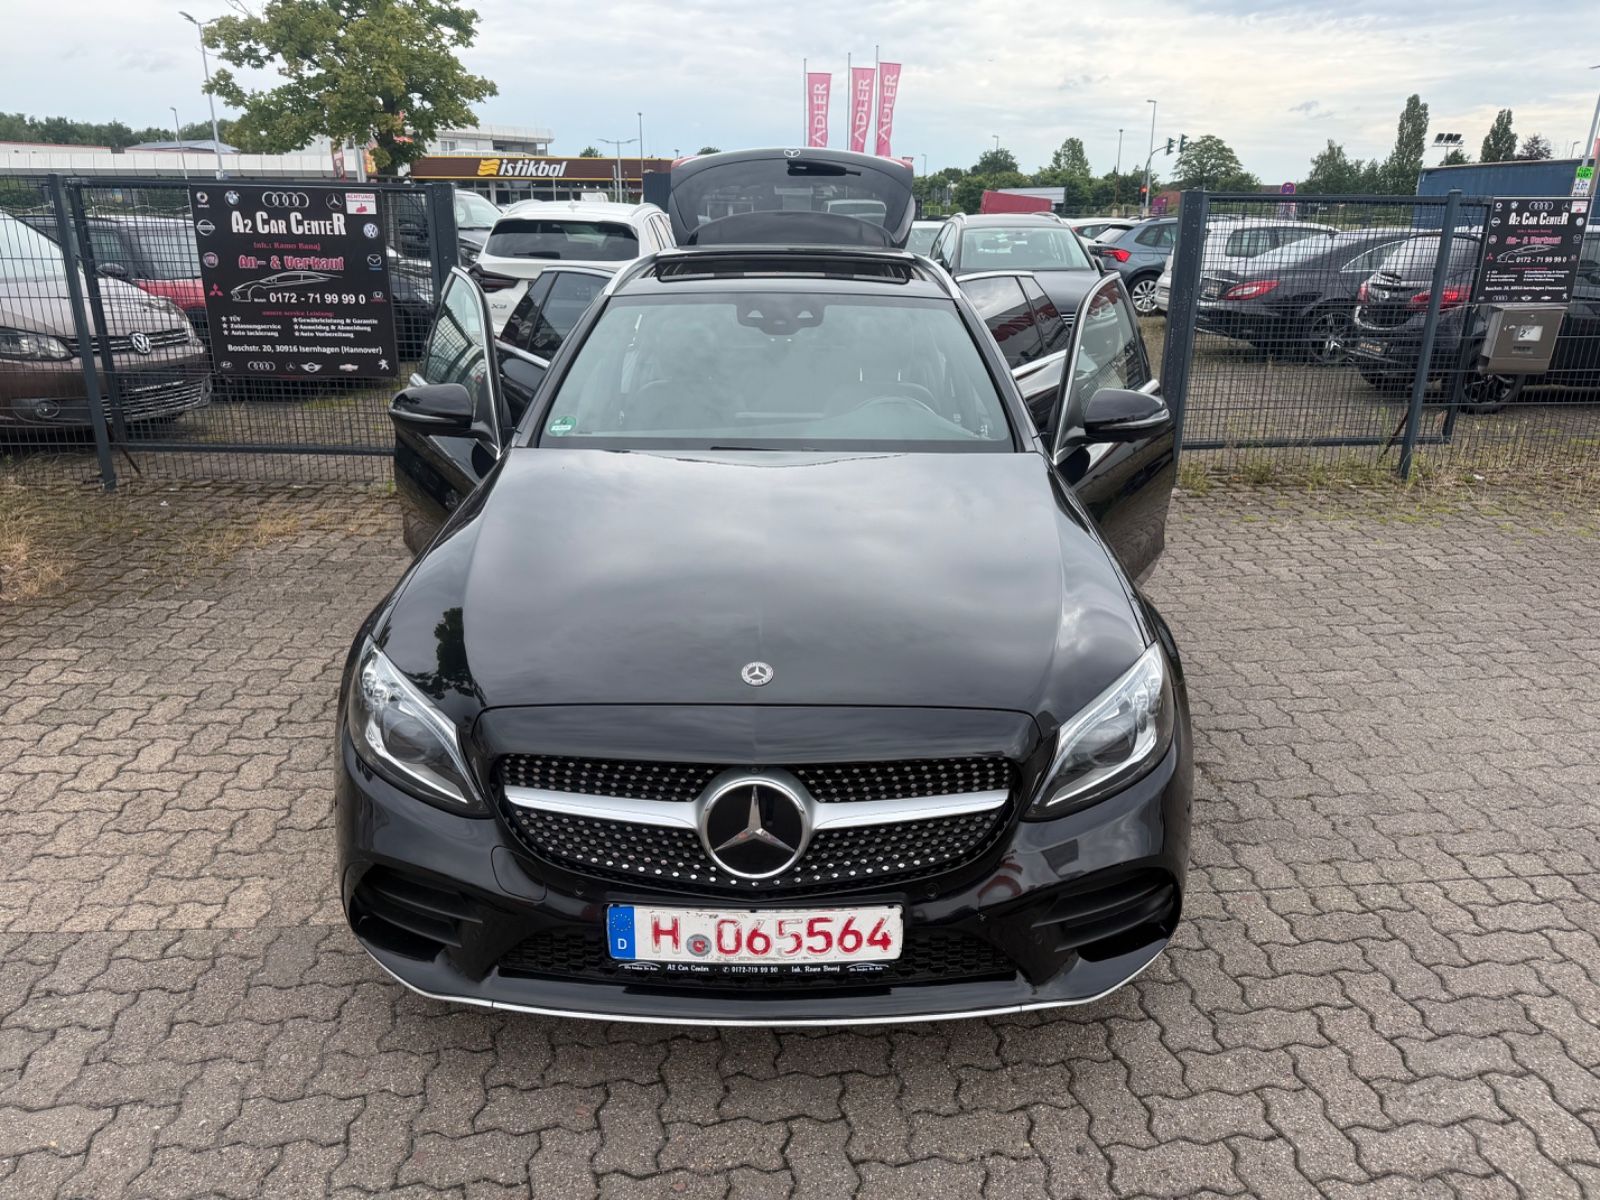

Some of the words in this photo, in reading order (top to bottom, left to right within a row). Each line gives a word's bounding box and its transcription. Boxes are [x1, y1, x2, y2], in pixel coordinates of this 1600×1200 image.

[812, 83, 828, 146] ADLER
[853, 79, 871, 143] ADLER
[878, 74, 898, 141] ADLER
[499, 159, 568, 177] istikbal
[231, 211, 253, 233] A2
[1508, 212, 1520, 225] A2
[238, 255, 267, 269] An-
[270, 255, 281, 269] &
[283, 255, 344, 270] Verkauf
[269, 292, 298, 304] 0172
[307, 292, 321, 304] 71
[324, 293, 339, 304] 99
[341, 293, 356, 304] 99
[358, 294, 366, 304] 0
[227, 344, 261, 352] Boschstr.
[262, 344, 274, 353] 20,
[299, 345, 340, 354] Isernhagen
[341, 345, 382, 355] (Hannover)
[617, 938, 628, 950] D
[651, 914, 682, 954] H
[715, 914, 893, 957] 065564
